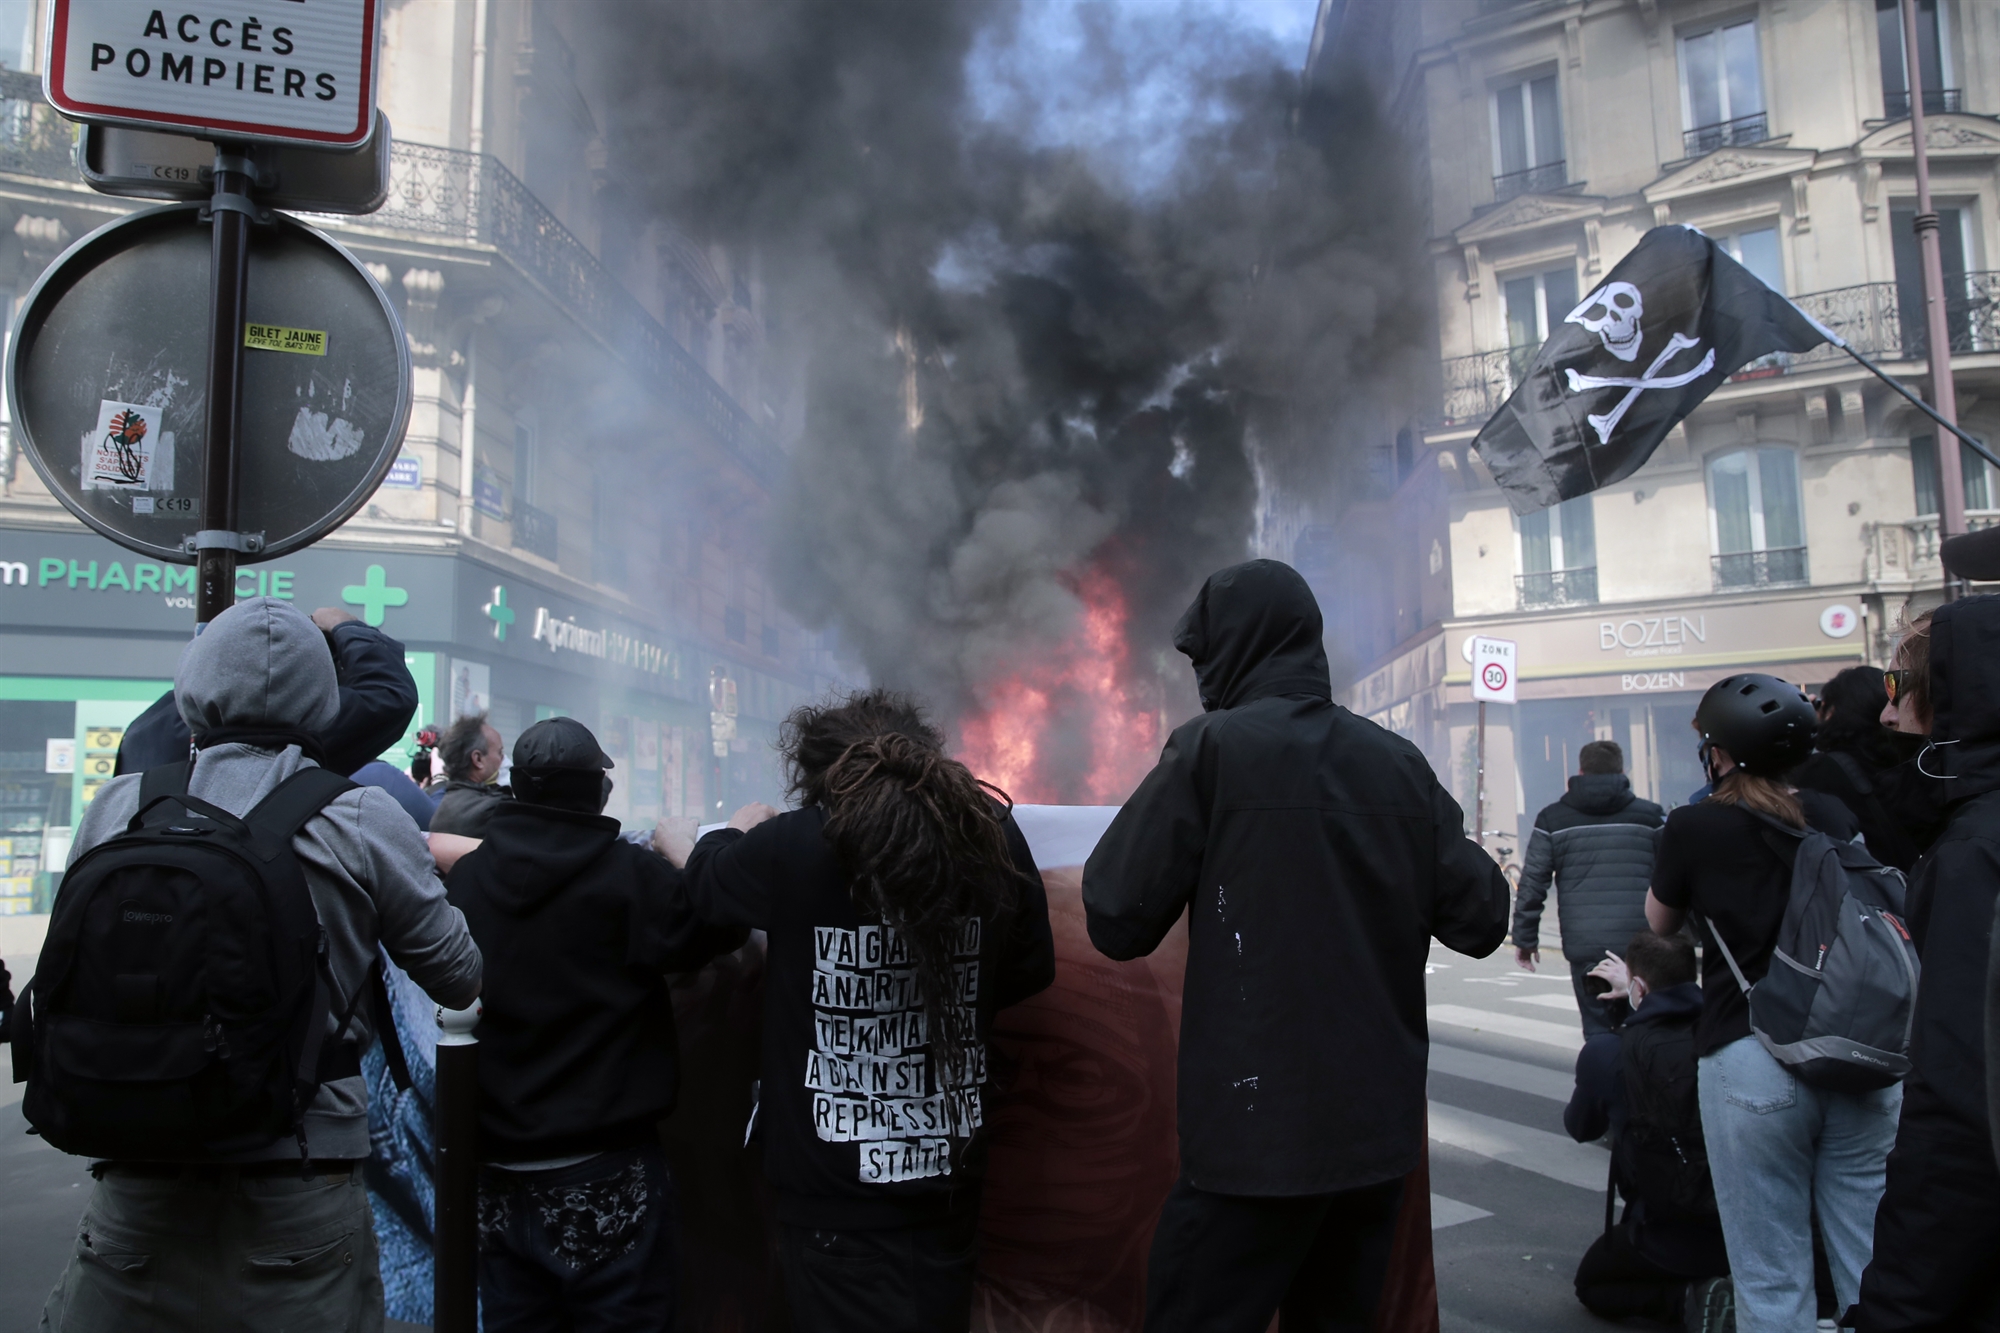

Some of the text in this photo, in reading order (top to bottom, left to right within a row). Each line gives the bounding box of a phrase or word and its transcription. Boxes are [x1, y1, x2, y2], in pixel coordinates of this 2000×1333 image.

[143, 10, 294, 55] ACCÈS
[90, 43, 338, 101] POMPIERS
[249, 326, 322, 344] GILET JAUNE
[284, 342, 304, 350] BATS
[38, 557, 295, 599] PHARMCIE
[1600, 615, 1705, 650] BOZEN
[1482, 644, 1508, 657] ZONE
[1487, 670, 1502, 684] 30
[1622, 672, 1684, 691] BOZEN
[808, 1052, 925, 1094] AGAINST
[817, 1089, 981, 1134] REPRESSIVE
[868, 1142, 948, 1178] STATE
